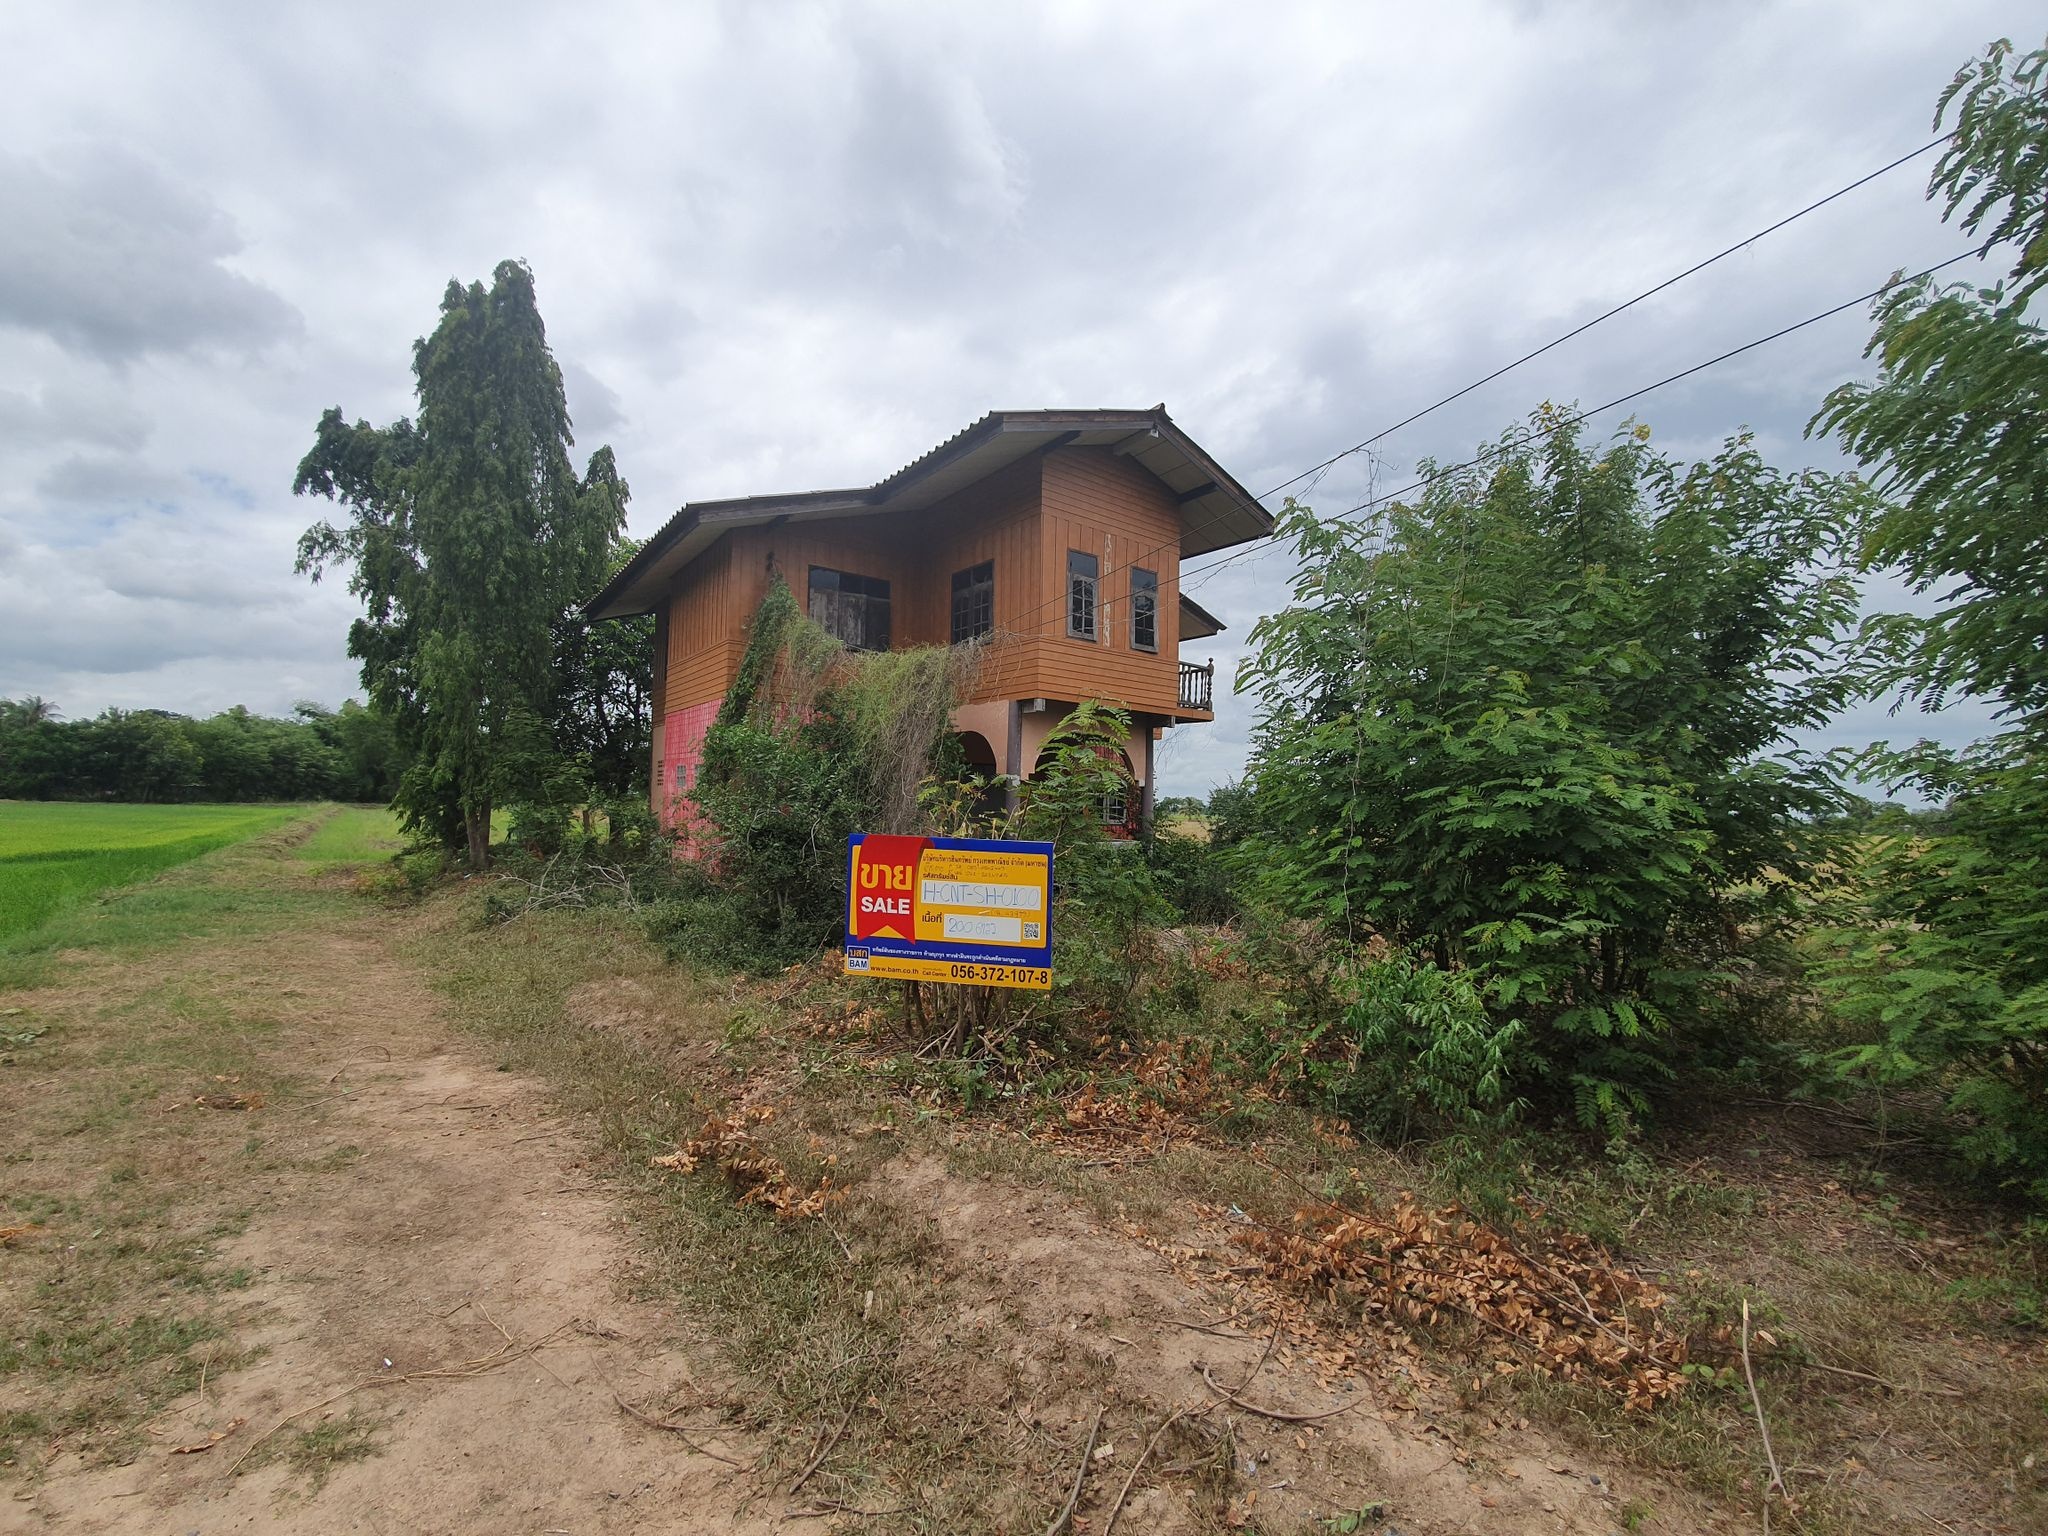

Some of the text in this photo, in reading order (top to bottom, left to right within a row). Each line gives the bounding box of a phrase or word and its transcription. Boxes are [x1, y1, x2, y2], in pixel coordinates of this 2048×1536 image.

[860, 863, 912, 890] ขาย
[861, 896, 910, 915] SALE
[922, 911, 942, 924] เนื้อที่
[849, 949, 868, 958] บสก
[849, 959, 868, 969] BAM
[870, 966, 919, 975] www.bam.co.th
[951, 964, 1048, 985] 056-372-107-8
